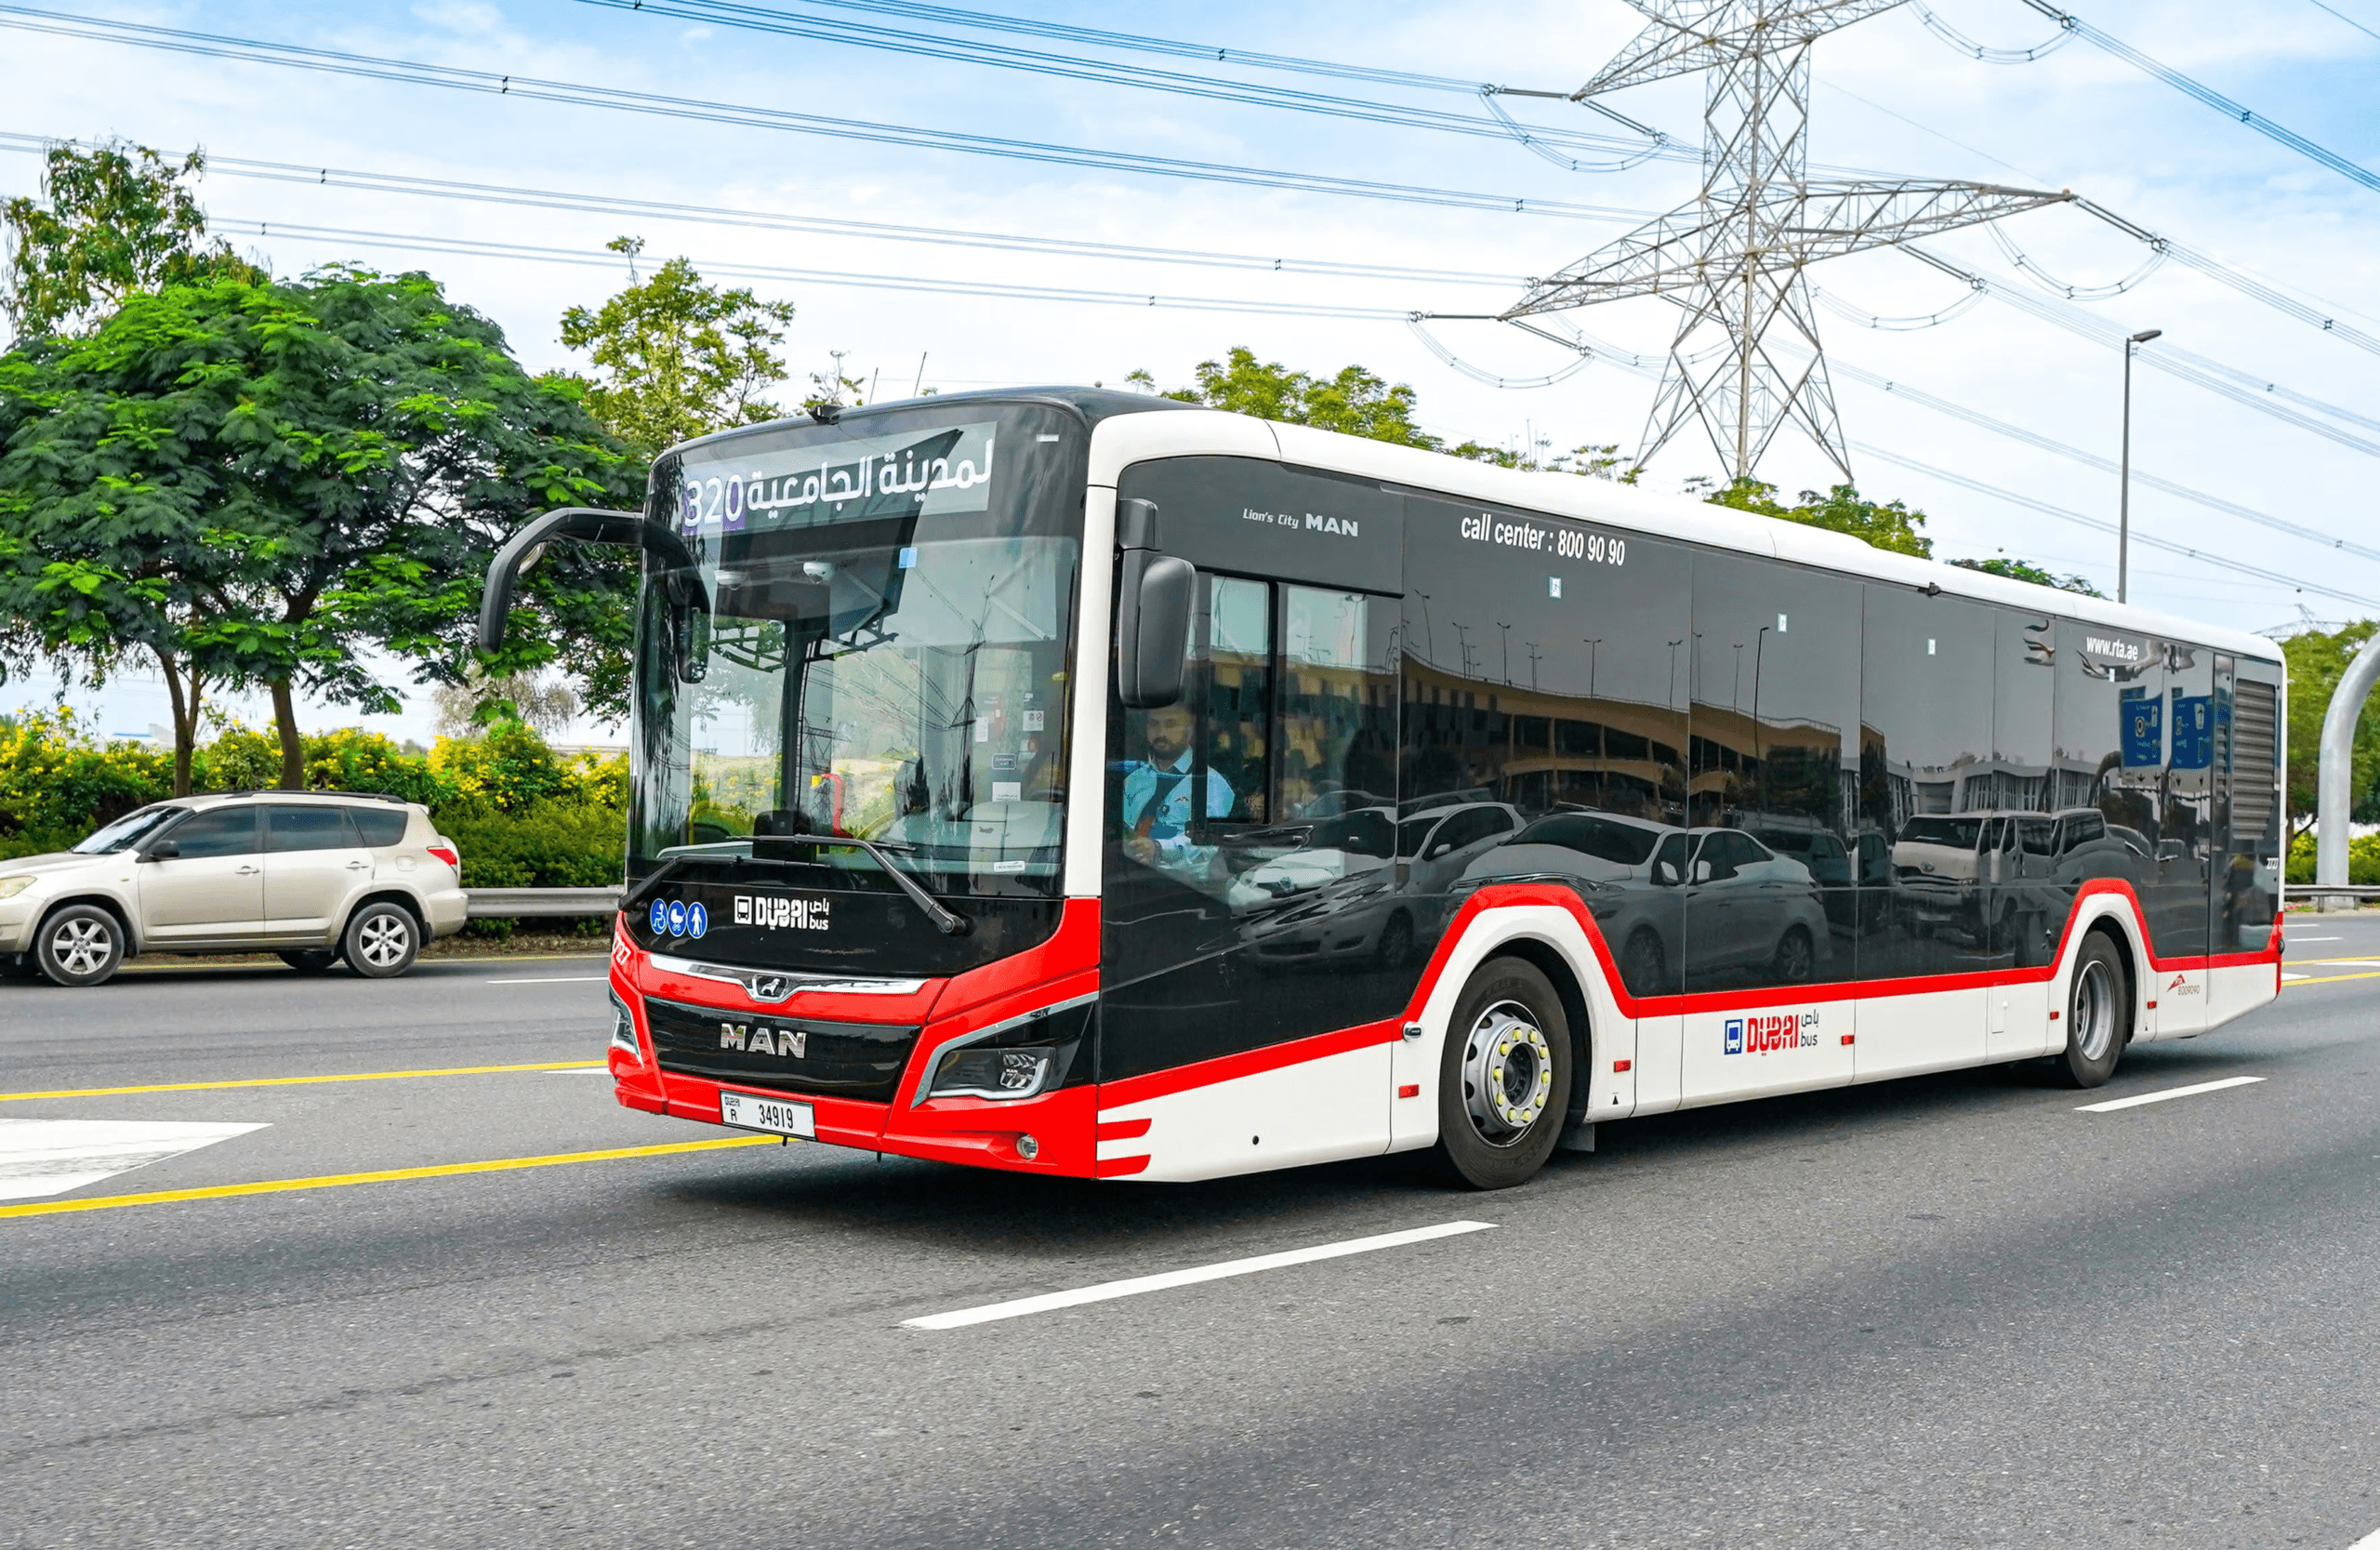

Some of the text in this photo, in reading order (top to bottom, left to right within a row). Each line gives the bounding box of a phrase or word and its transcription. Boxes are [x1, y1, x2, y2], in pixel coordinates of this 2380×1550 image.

[685, 473, 744, 527] 320
[747, 455, 872, 520] الجامعية
[1243, 508, 1299, 529] Lion's City
[1305, 512, 1358, 537] MAN
[1461, 512, 1491, 542] call
[1494, 523, 1545, 550] center
[1557, 528, 1584, 559] 800
[1587, 534, 1606, 563] 90
[1607, 537, 1626, 566] 90
[2086, 636, 2138, 661] www.rta.ae
[755, 896, 808, 930] DUBAI
[809, 897, 829, 916] باص
[809, 915, 829, 930] bus
[1801, 1008, 1819, 1028] باص
[720, 1022, 807, 1059] MAN
[1747, 1013, 1800, 1056] DUBAI
[1801, 1031, 1818, 1048] bus
[730, 1103, 794, 1130] R 34919
